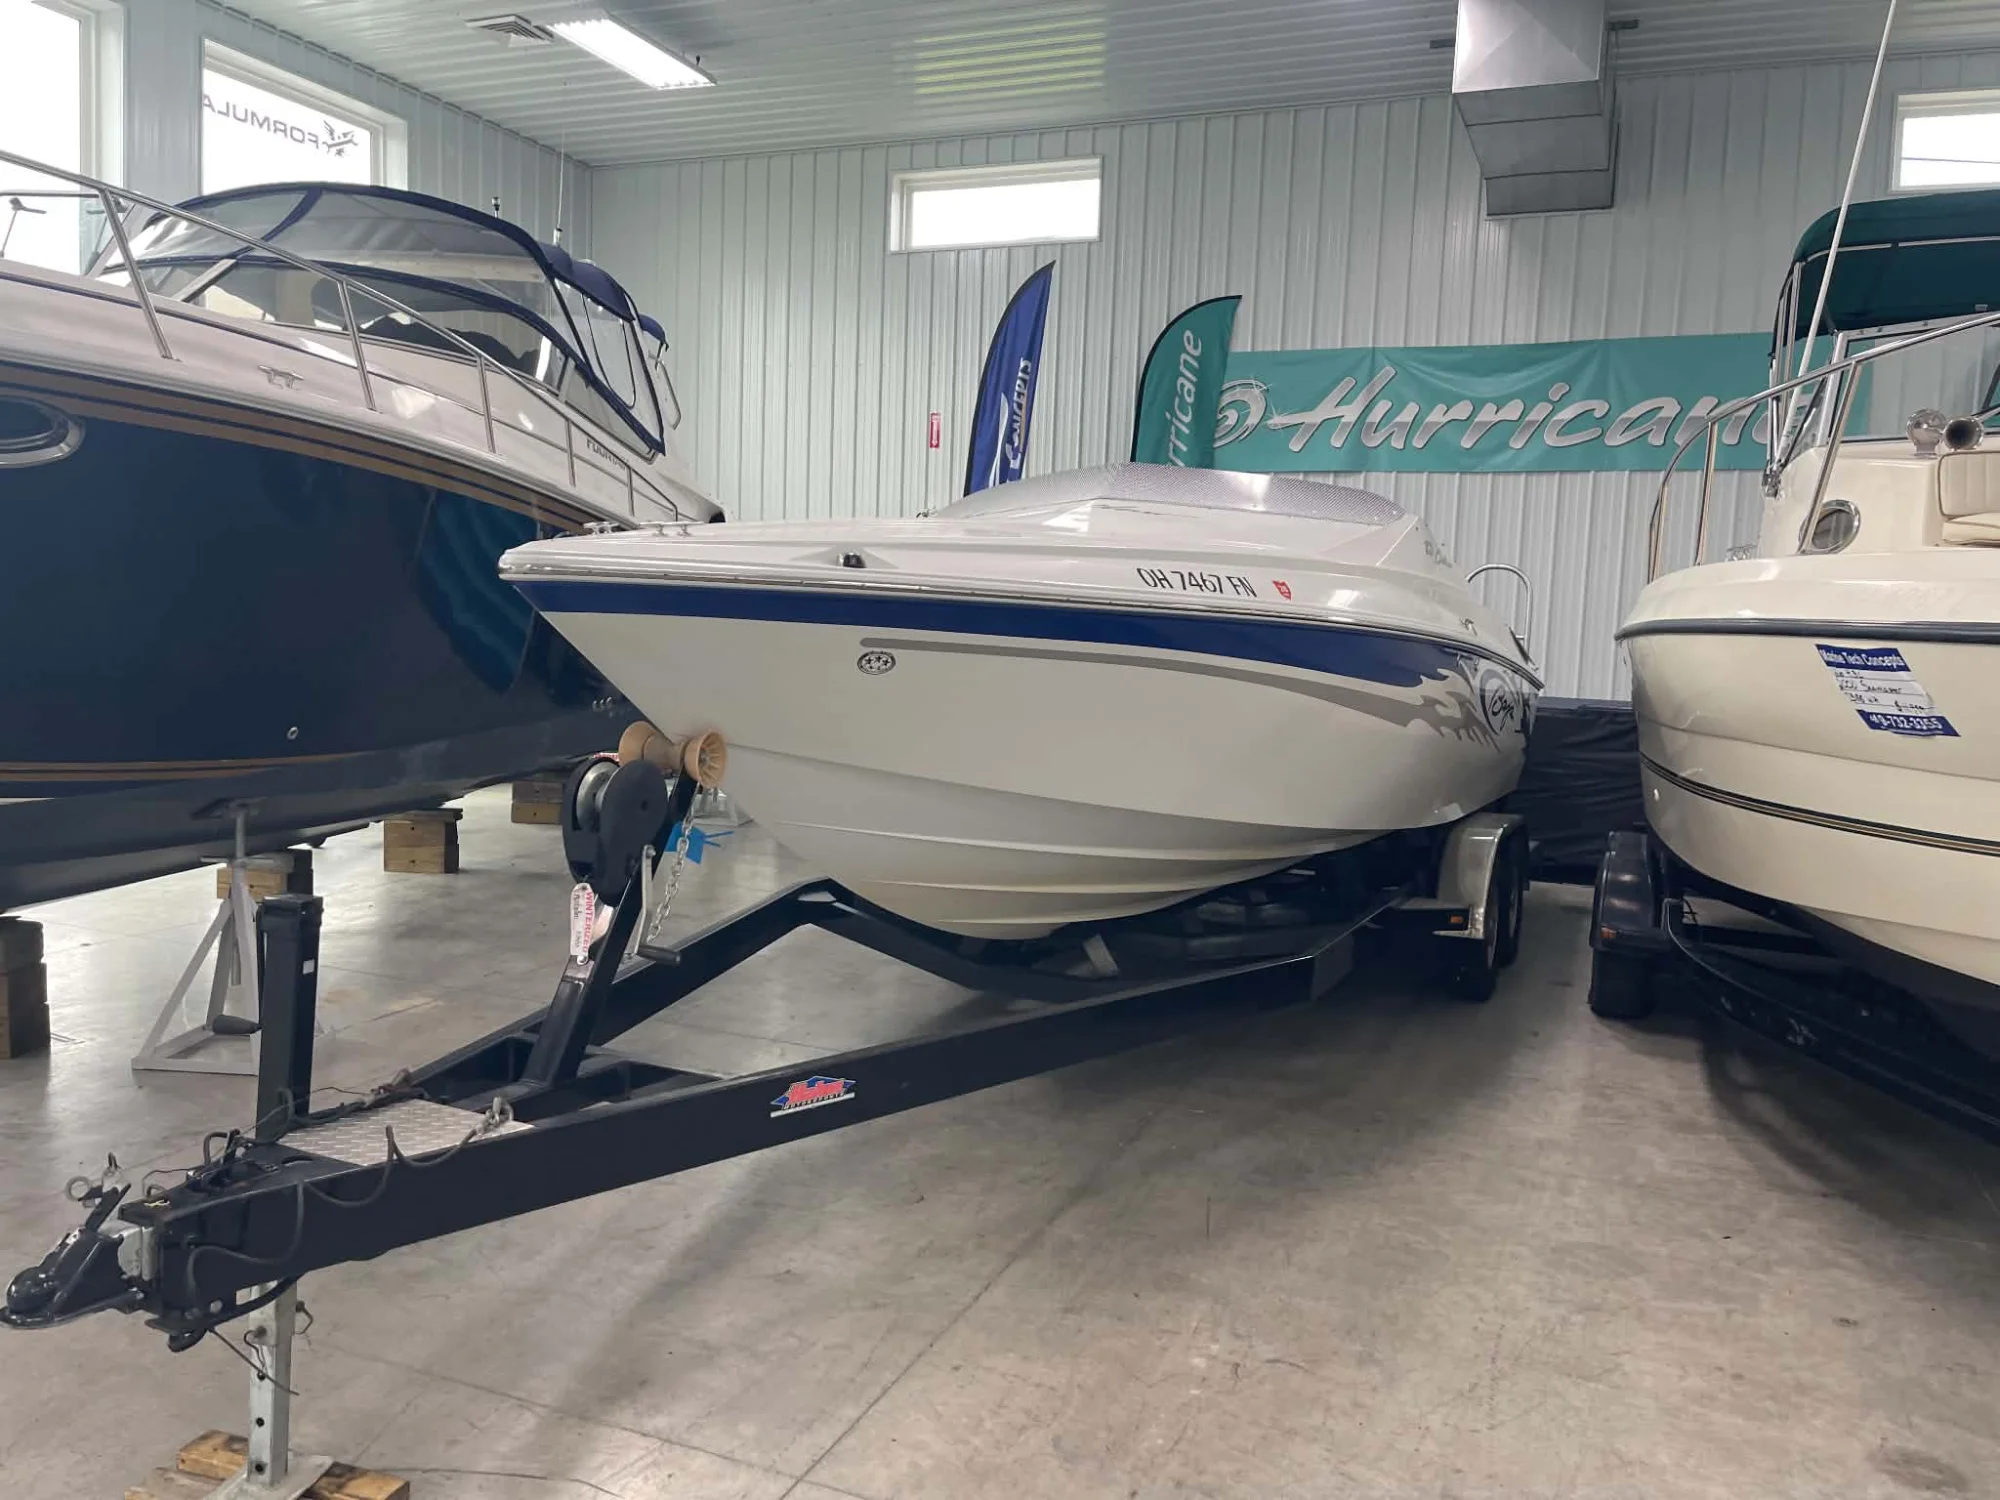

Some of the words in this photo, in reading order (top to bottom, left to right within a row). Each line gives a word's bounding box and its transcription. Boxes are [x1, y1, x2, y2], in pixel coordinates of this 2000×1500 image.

[1136, 567, 1174, 589] OH
[1171, 570, 1224, 594] 7467
[1226, 575, 1258, 598] FN
[583, 889, 594, 953] WINTERIZED
